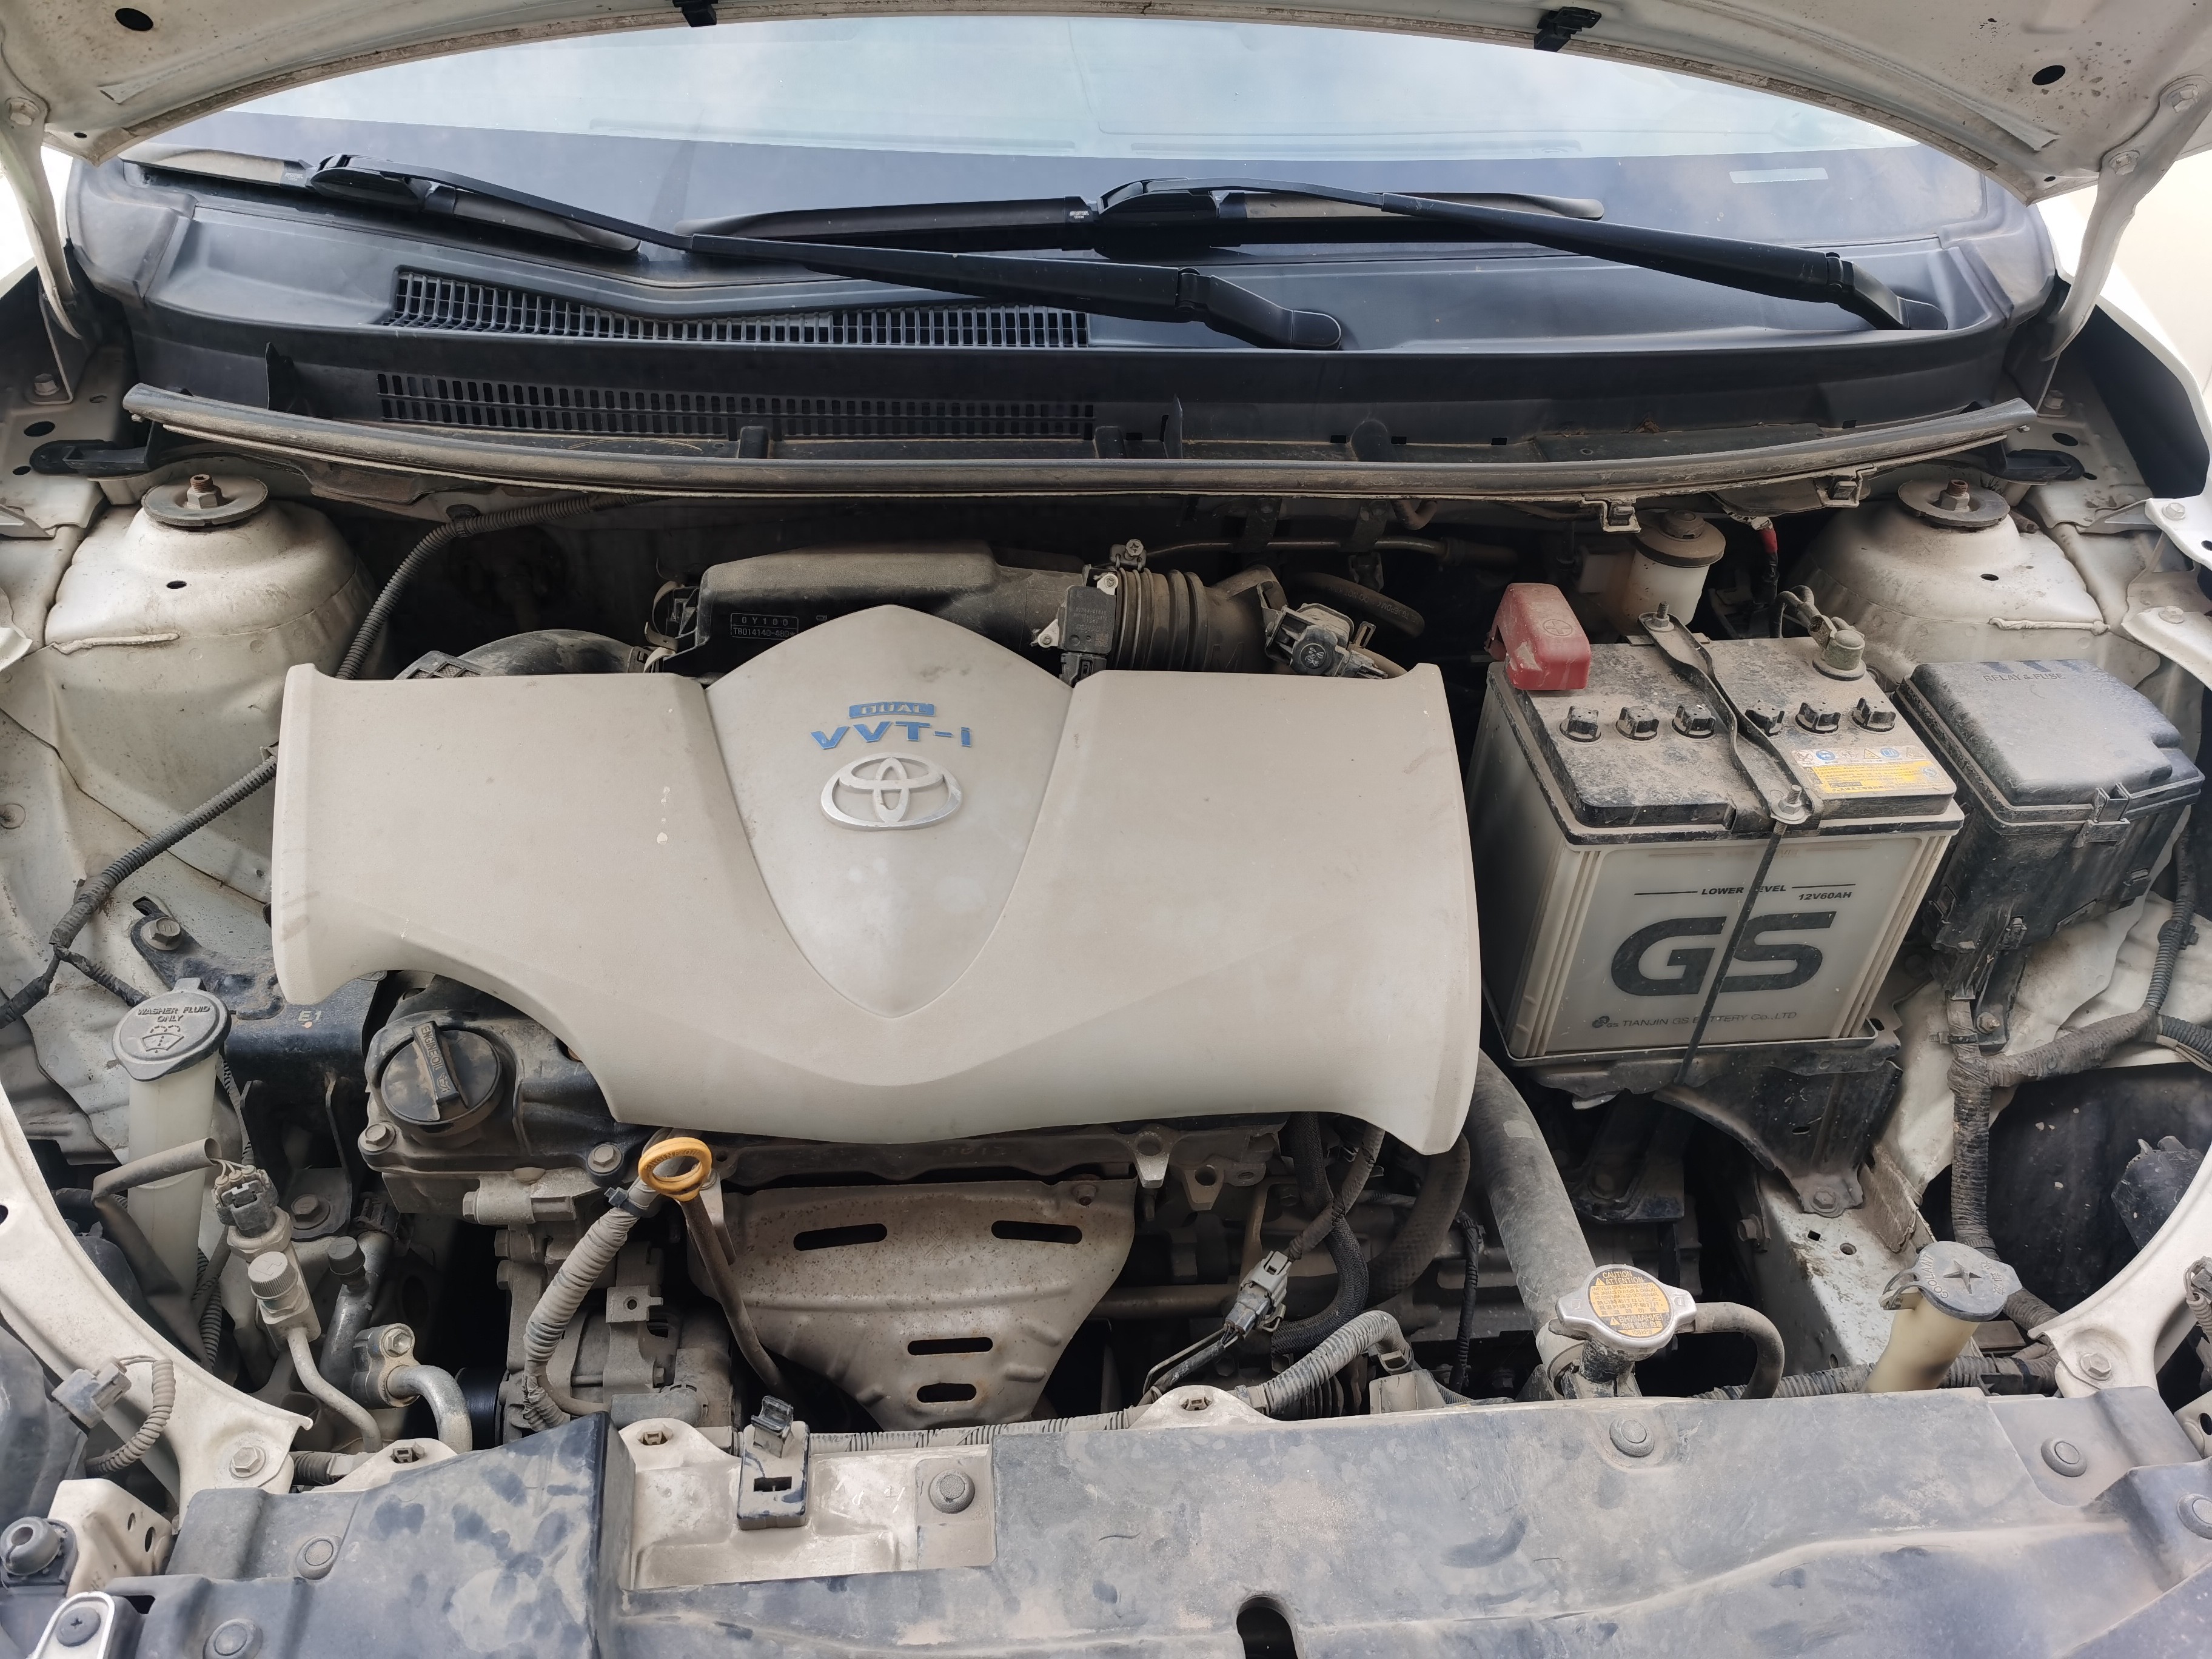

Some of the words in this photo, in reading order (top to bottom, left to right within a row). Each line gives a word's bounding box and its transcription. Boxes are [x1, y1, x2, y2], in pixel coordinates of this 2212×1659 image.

[1983, 673, 2021, 682] RELAY
[861, 702, 927, 714] DUAL
[810, 720, 973, 751] VVT-i
[1701, 886, 1744, 896] LOWER
[1798, 891, 1852, 900] 12V60AH
[1610, 911, 1837, 996] GS
[138, 1007, 178, 1016] WASHER
[183, 1005, 212, 1014] FLUID
[157, 1014, 184, 1023] ONLY
[1623, 1019, 1669, 1027] TIANJIN
[420, 1025, 439, 1056] ENGINE
[432, 1056, 443, 1071] OIL
[645, 1150, 680, 1170] ENGINE
[1602, 1270, 1633, 1279] CAUTION
[1606, 1276, 1644, 1285] ATTENTION
